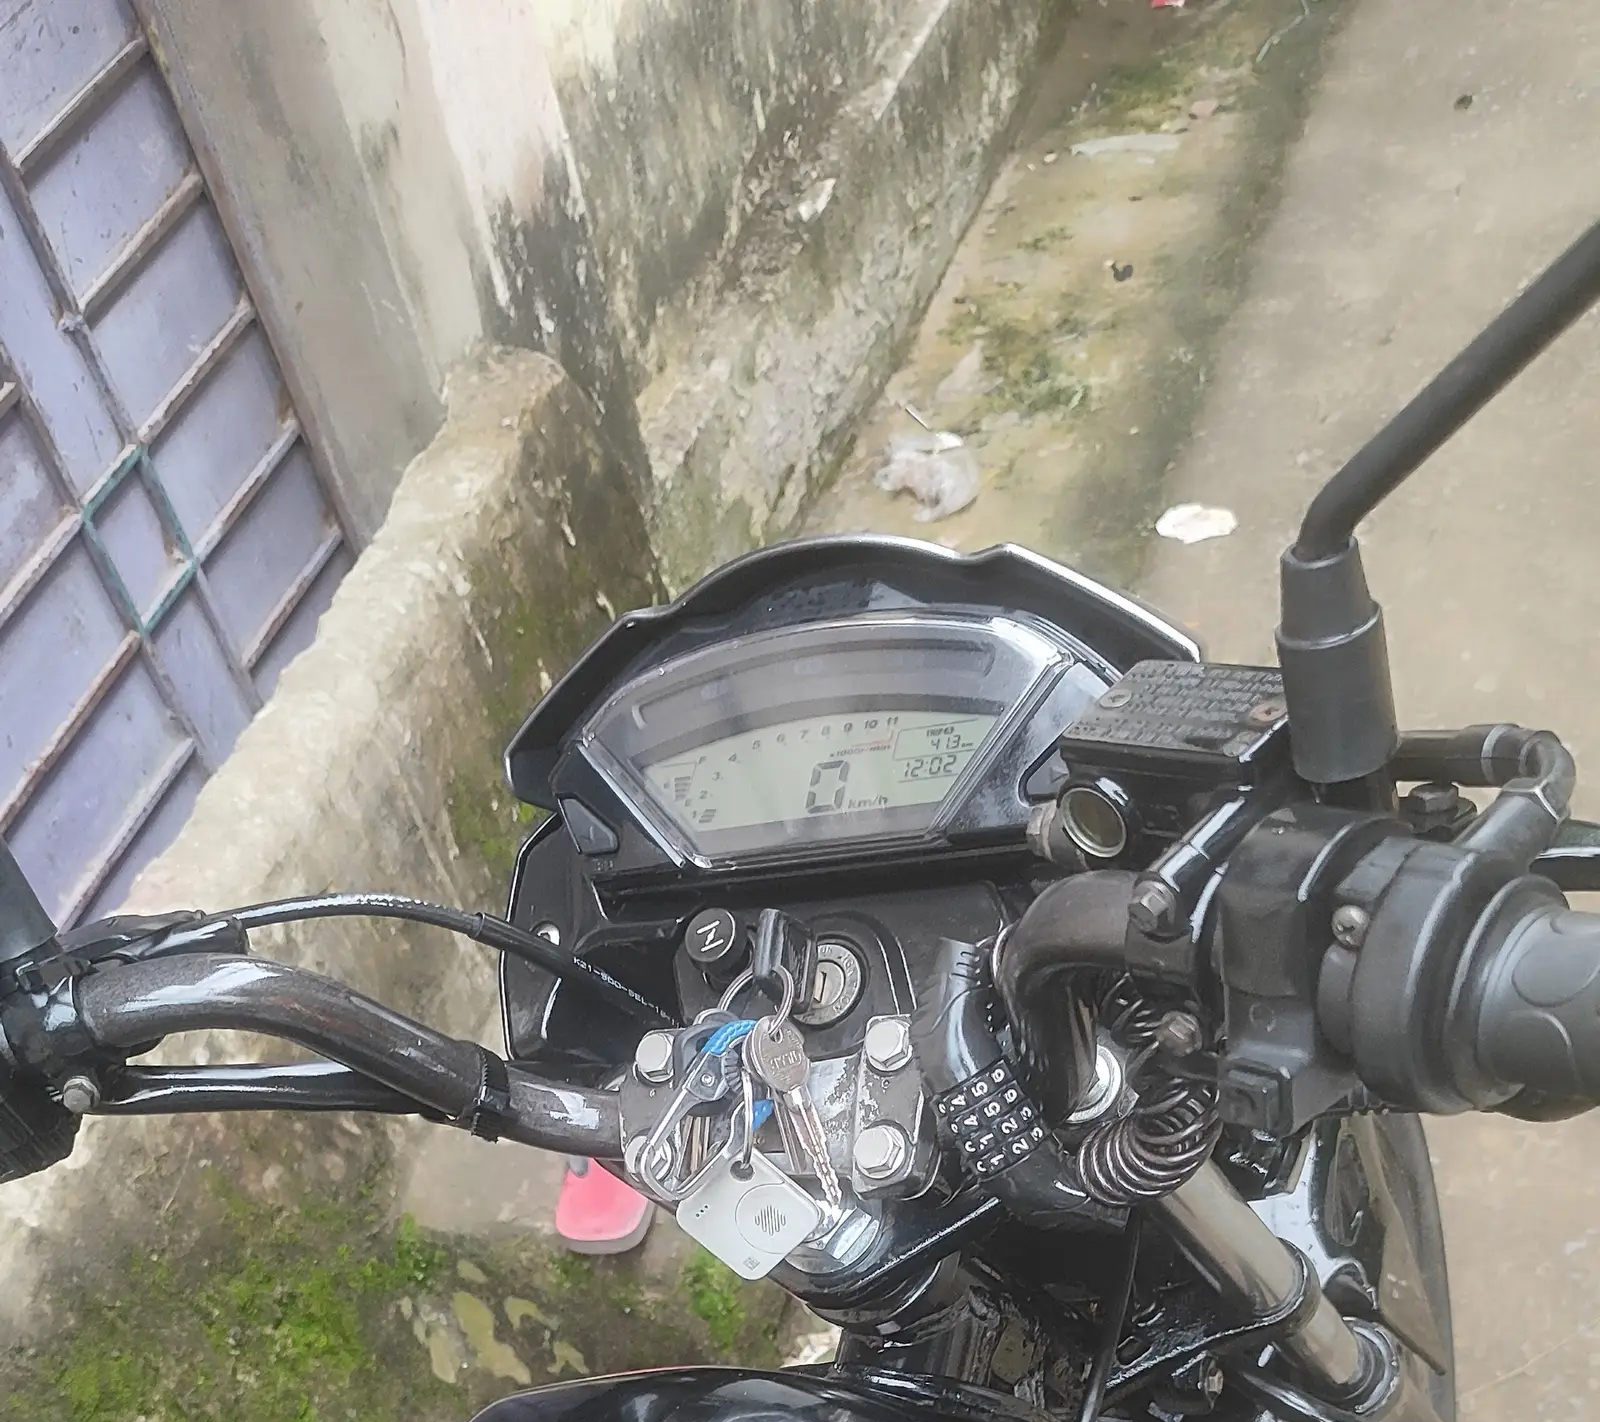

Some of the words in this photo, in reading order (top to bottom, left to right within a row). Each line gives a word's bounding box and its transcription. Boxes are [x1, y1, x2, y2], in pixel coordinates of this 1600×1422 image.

[800, 730, 808, 739] 7
[864, 719, 878, 730] 10
[887, 716, 899, 726] 11
[904, 755, 957, 778] 12:02
[805, 760, 850, 814] 0
[848, 794, 889, 809] km/h
[971, 1081, 988, 1097] 5
[983, 1101, 1001, 1118] 5
[1001, 1117, 1018, 1134] 2
[1012, 1138, 1030, 1155] 2
